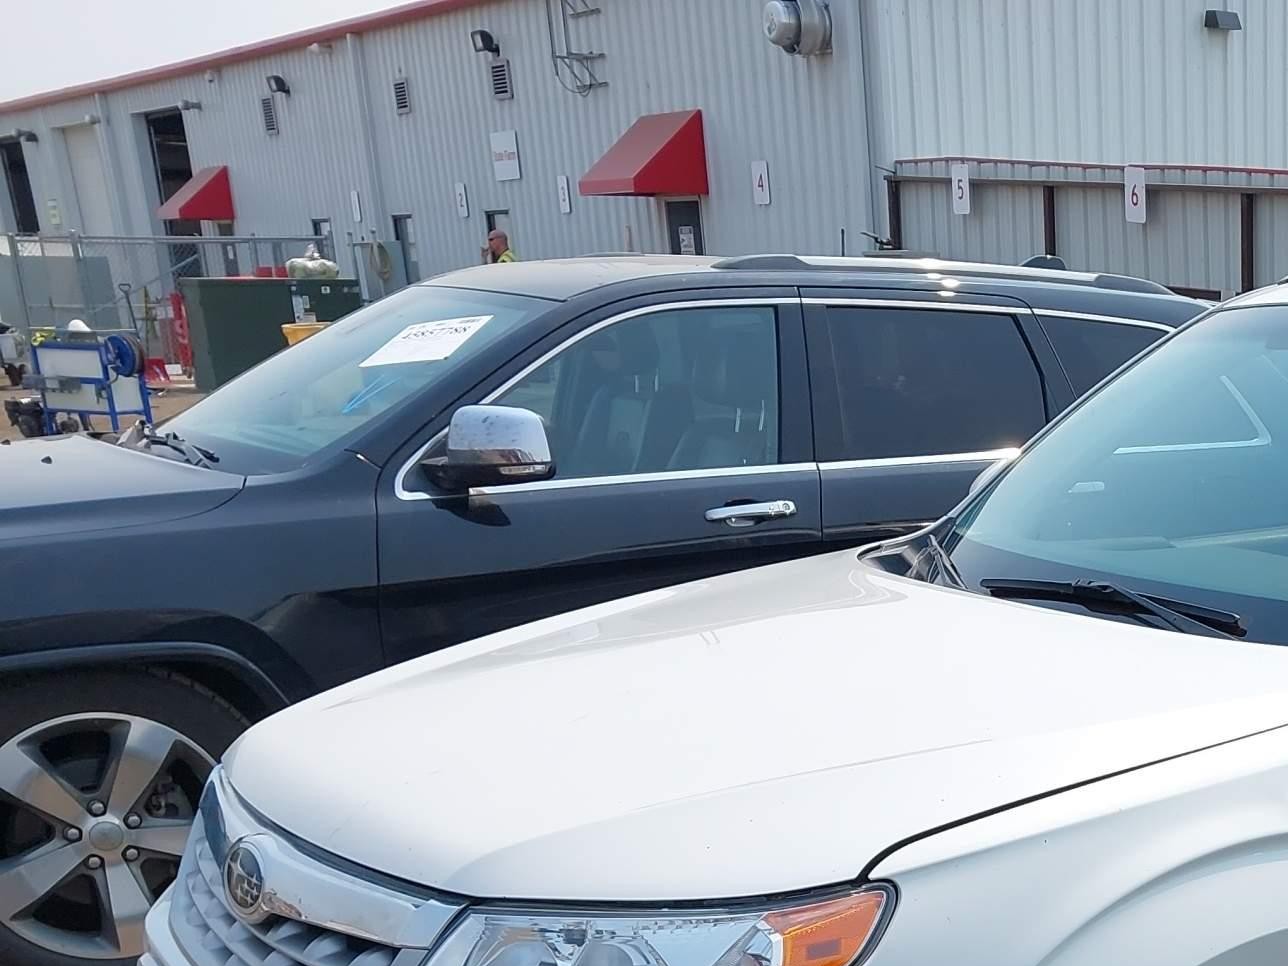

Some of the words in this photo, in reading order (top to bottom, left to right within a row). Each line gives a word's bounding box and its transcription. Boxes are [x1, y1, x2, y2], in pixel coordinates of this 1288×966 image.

[757, 173, 764, 193] 4
[957, 179, 964, 200] 5
[1131, 184, 1139, 206] 6
